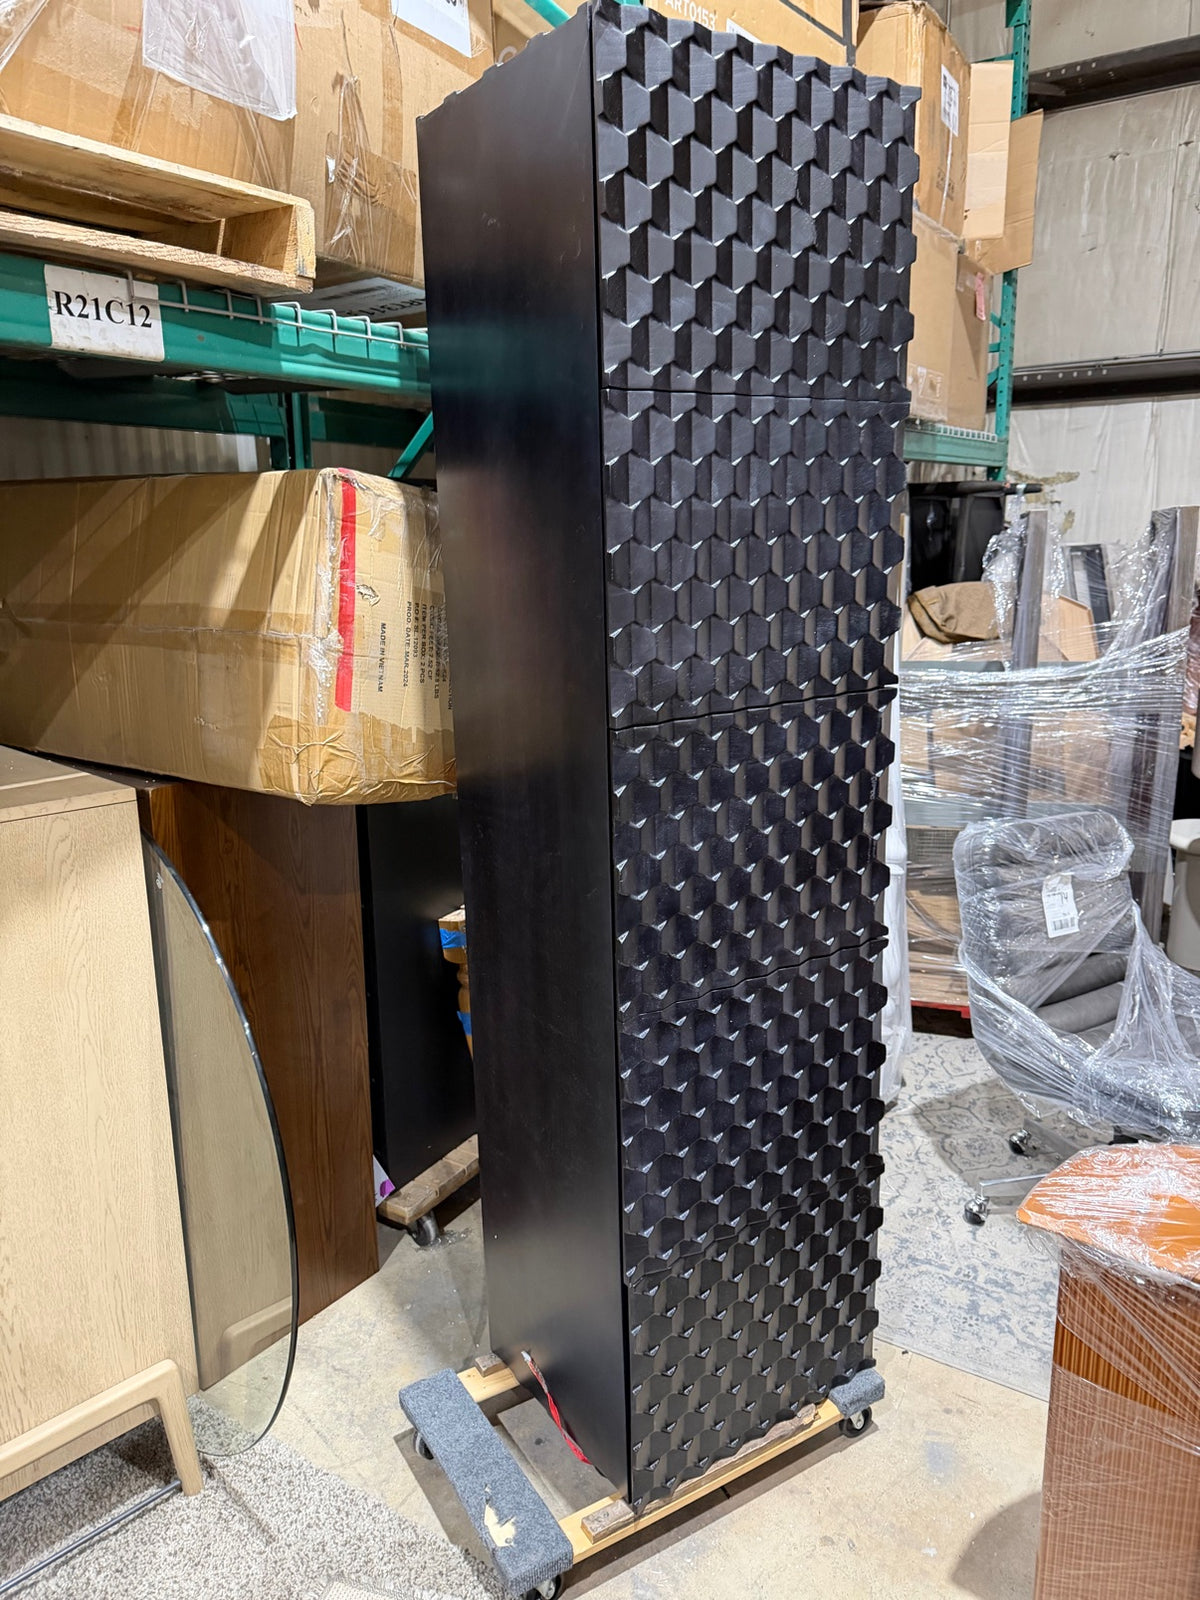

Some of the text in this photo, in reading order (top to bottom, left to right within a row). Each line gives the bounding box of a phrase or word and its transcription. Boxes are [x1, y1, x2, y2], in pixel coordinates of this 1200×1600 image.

[52, 290, 153, 328] R21C12
[379, 647, 385, 656] IN
[377, 658, 385, 692] VIETNAM
